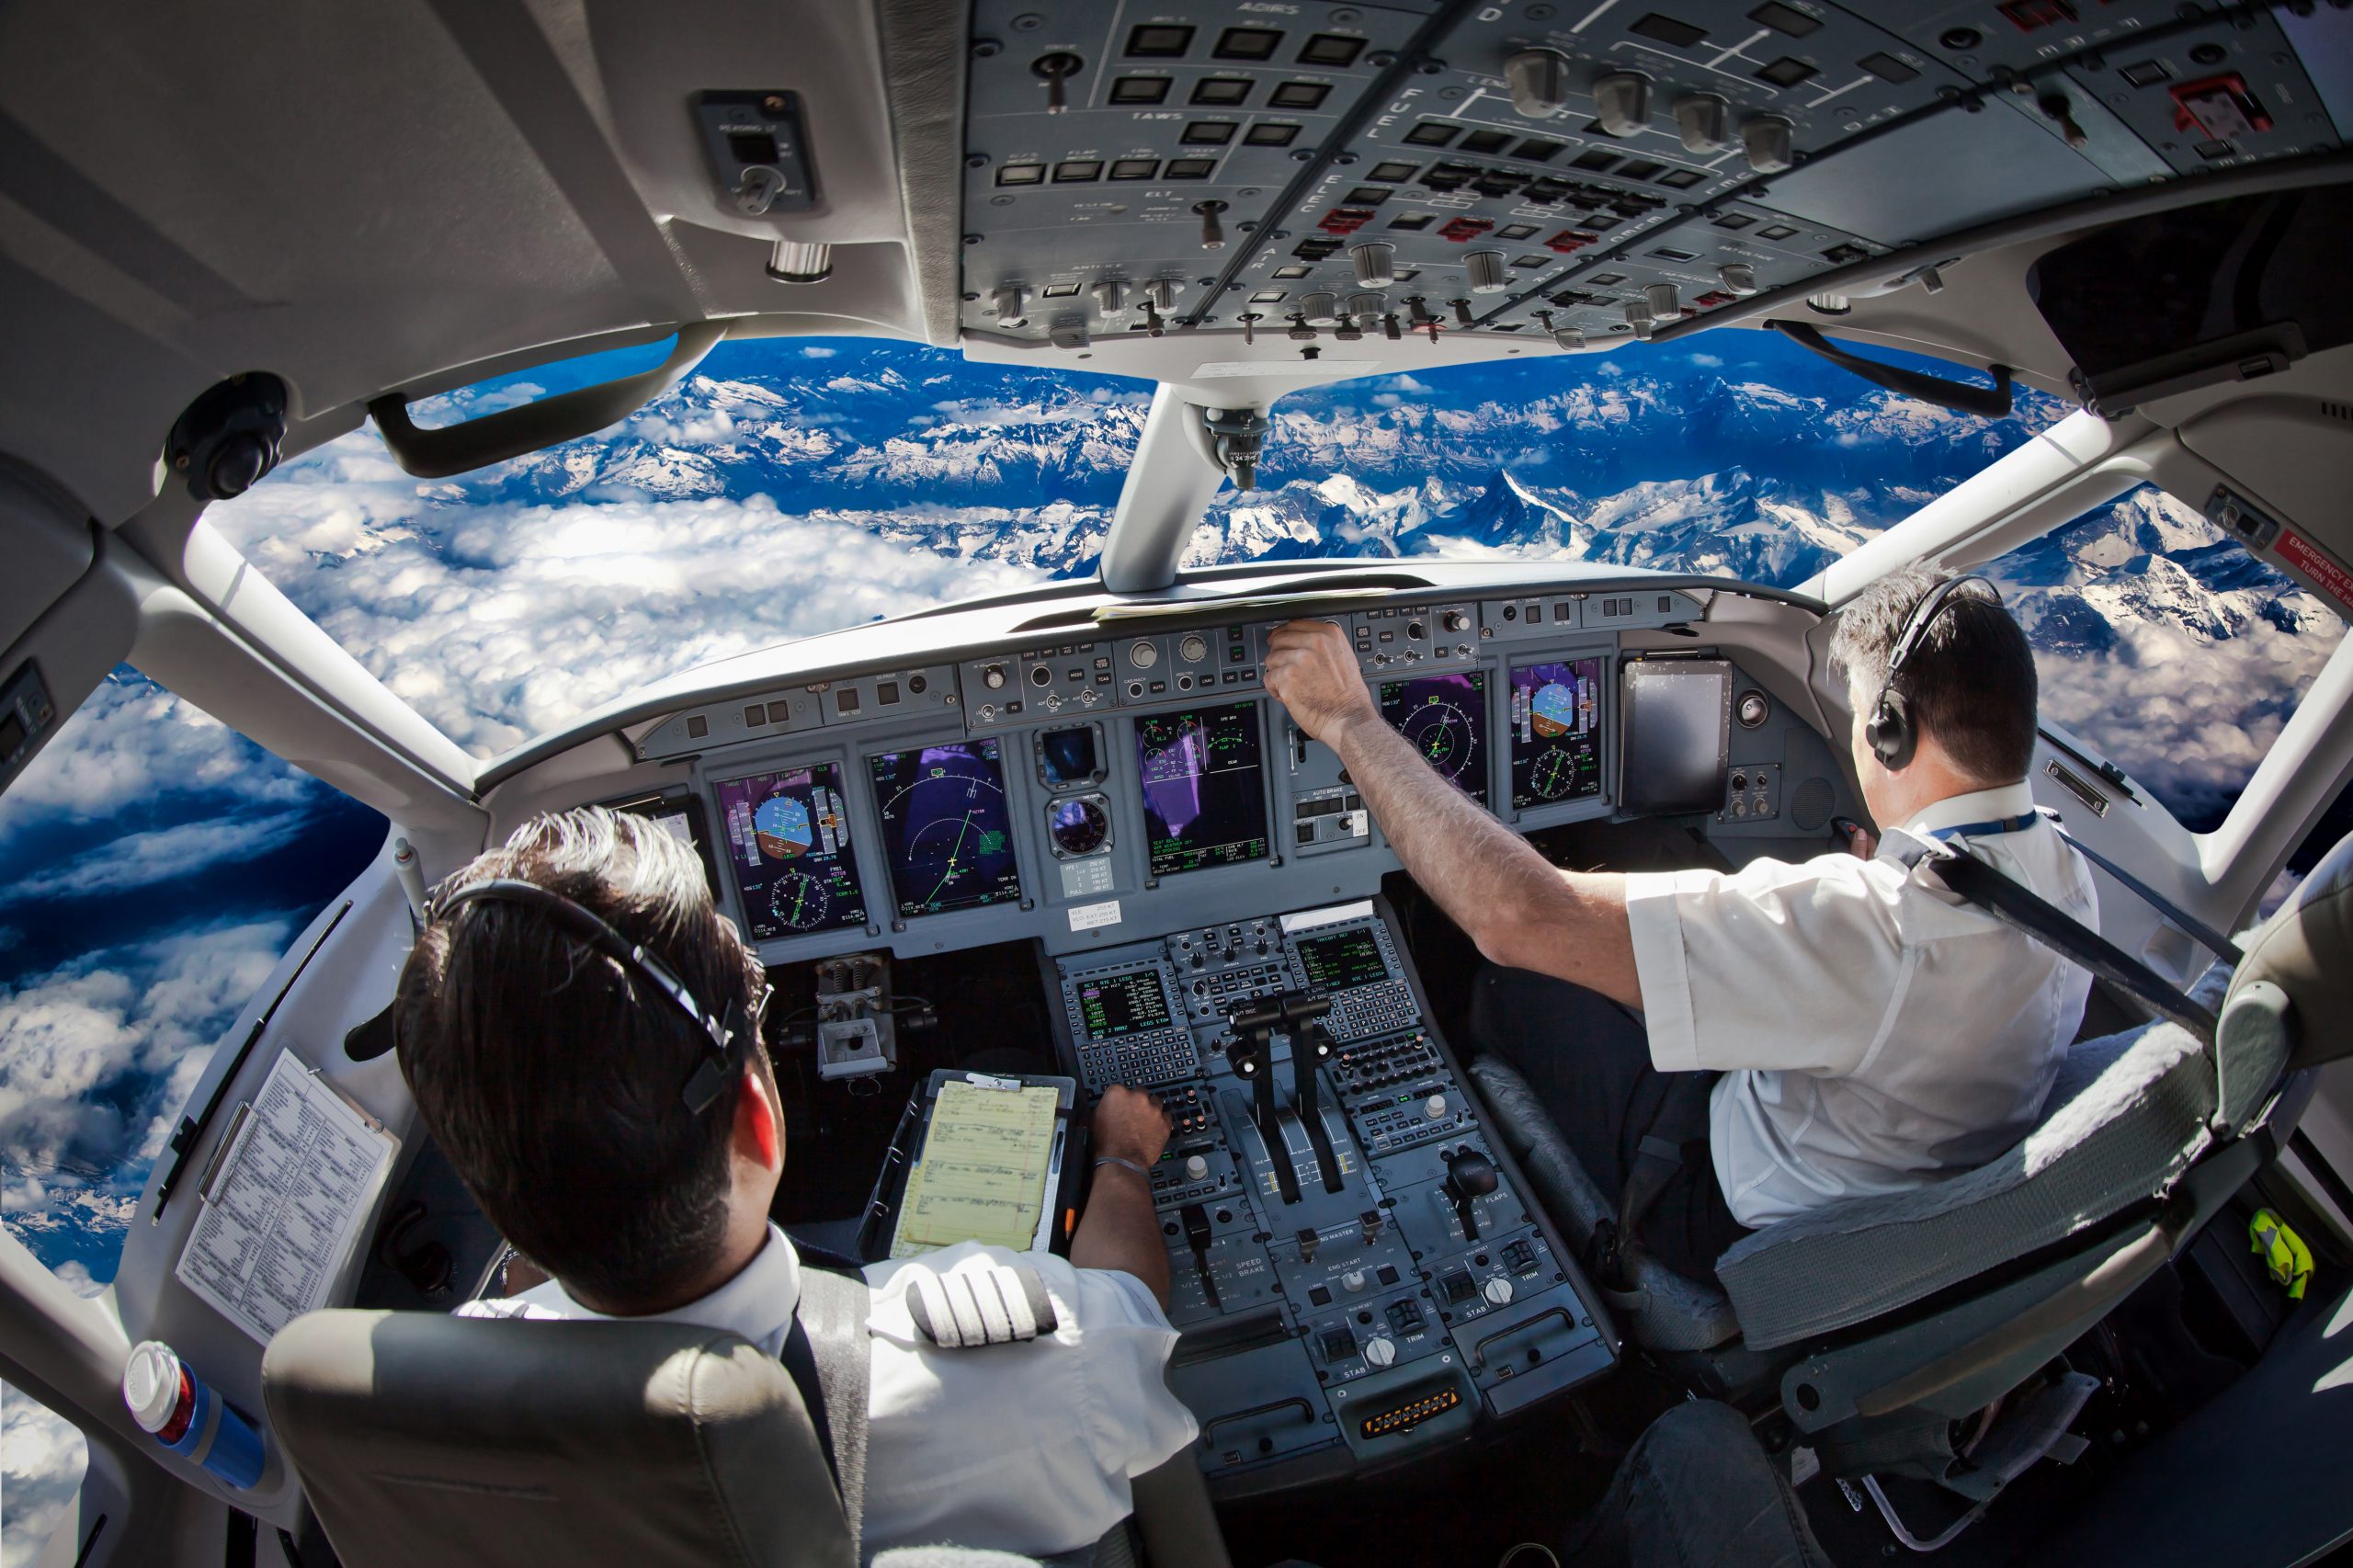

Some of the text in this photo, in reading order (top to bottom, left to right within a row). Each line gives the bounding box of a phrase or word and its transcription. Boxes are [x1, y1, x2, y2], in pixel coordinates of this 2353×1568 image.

[2289, 536, 2345, 580] EMERGENCY
[2300, 560, 2325, 584] TURN
[2325, 579, 2345, 597] THE
[1484, 1192, 1508, 1204] FLAPS
[1329, 1229, 1354, 1239] MASTER
[1474, 1244, 1489, 1254] RESET
[1235, 1257, 1262, 1269] SPEED
[1327, 1257, 1361, 1272] ENG START
[1238, 1265, 1266, 1277] BRAKE
[1521, 1271, 1539, 1282] TRIM
[1466, 1306, 1487, 1318] STAB
[1405, 1333, 1425, 1344] TRIM
[1344, 1367, 1366, 1379] STAB
